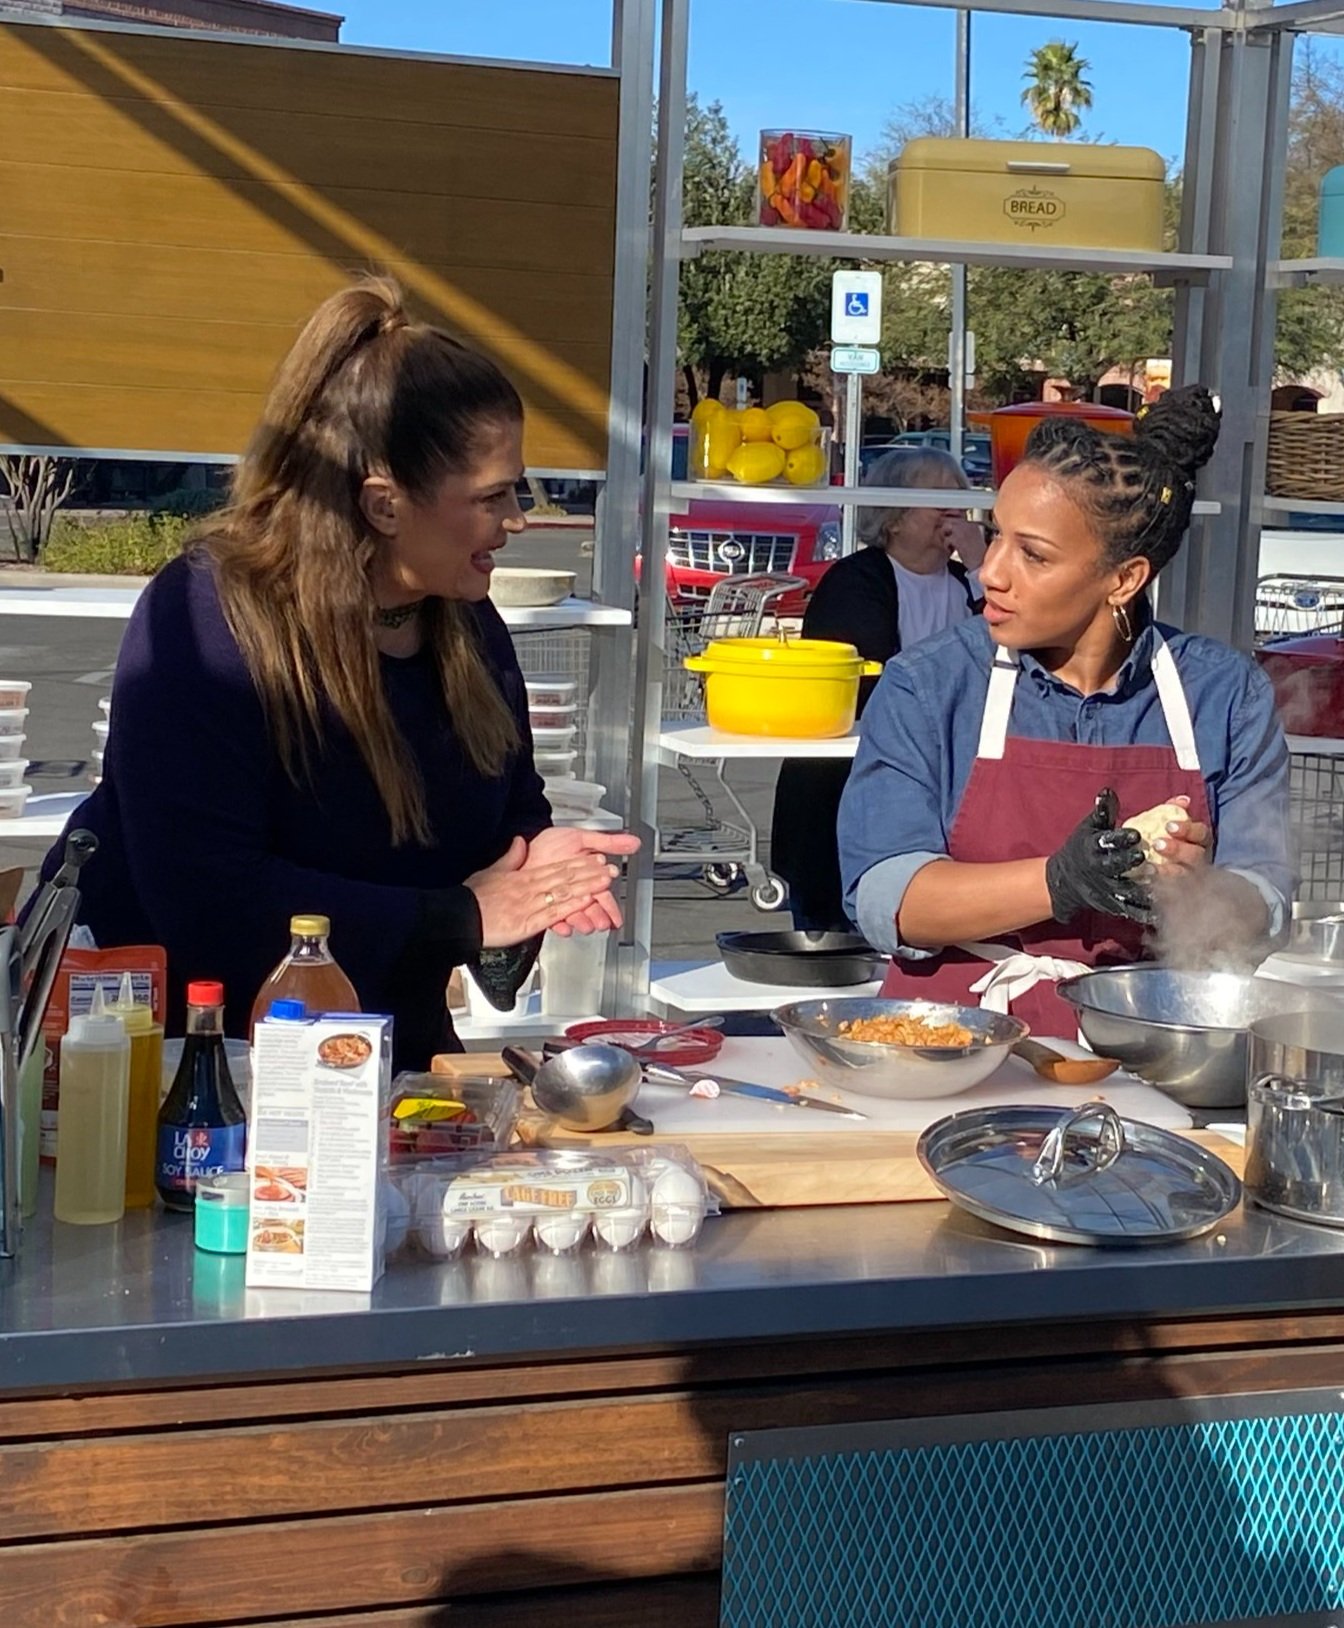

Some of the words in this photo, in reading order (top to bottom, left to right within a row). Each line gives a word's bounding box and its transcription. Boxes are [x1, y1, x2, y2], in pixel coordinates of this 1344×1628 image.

[1010, 200, 1057, 215] BREAD
[175, 1130, 192, 1146] LA
[162, 1162, 183, 1177] SOY
[186, 1165, 224, 1178] SAUCE
[540, 1187, 576, 1208] FREE
